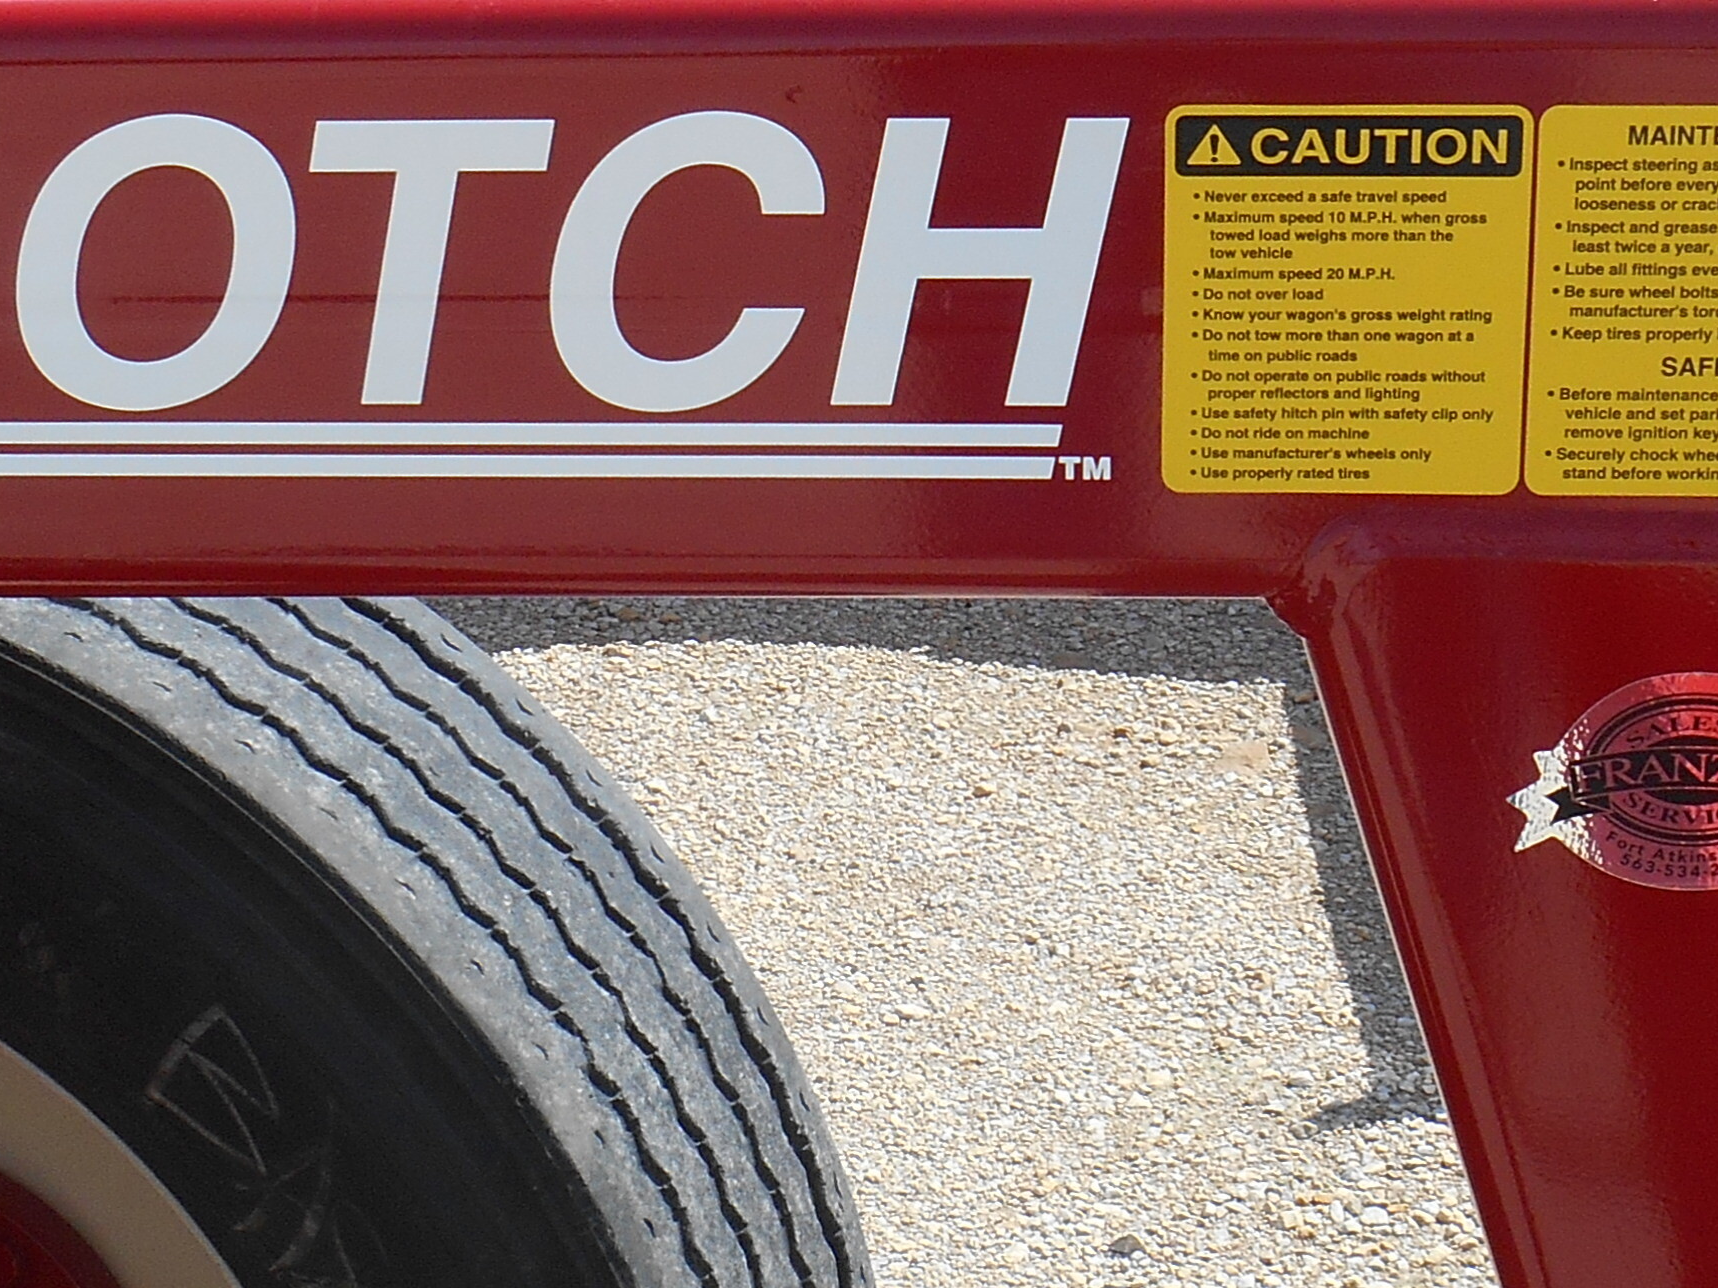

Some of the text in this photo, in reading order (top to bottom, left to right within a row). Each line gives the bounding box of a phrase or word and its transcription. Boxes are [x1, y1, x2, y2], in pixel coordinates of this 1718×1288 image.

[1249, 127, 1509, 165] CAUTION
[1569, 158, 1628, 172] Inspect
[1632, 159, 1698, 172] steering
[1575, 178, 1617, 192] point
[1620, 178, 1672, 190] before
[1204, 191, 1447, 205] Never exceed a safe travel speed
[1574, 198, 1656, 209] looseness
[1660, 200, 1678, 209] or
[1203, 211, 1487, 226] Maximum speed 10 M.P.H. when gross
[1566, 221, 1625, 235] Inspect
[1628, 222, 1659, 233] and
[1663, 224, 1718, 236] grease
[1209, 229, 1454, 243] towed load weighs more than the
[1572, 241, 1611, 252] least
[1614, 241, 1657, 252] twice
[1660, 243, 1670, 252] a
[1674, 243, 1714, 255] year,
[1203, 268, 1395, 282] Maximum speed 20 M.P.H.
[1564, 263, 1605, 274] Lube
[1608, 263, 1627, 274] all
[1631, 263, 1687, 277] fittings
[1203, 288, 1324, 300] Do not over load
[1203, 308, 1492, 323] Know your wagon's gross weight rating
[1562, 327, 1602, 341] Keep
[1605, 327, 1641, 339] tires
[1645, 327, 1713, 342] properly
[1201, 427, 1370, 439] Do not ride on machine
[1200, 447, 1432, 462] Use manufacturer's wheels only
[1556, 449, 1626, 463] Securely
[1629, 449, 1679, 461] chock
[1058, 457, 1113, 481] TM
[1200, 466, 1370, 481] Use properly rated tires
[1562, 467, 1607, 479] stand
[1610, 468, 1662, 479] before
[1605, 831, 1644, 856] Fort
